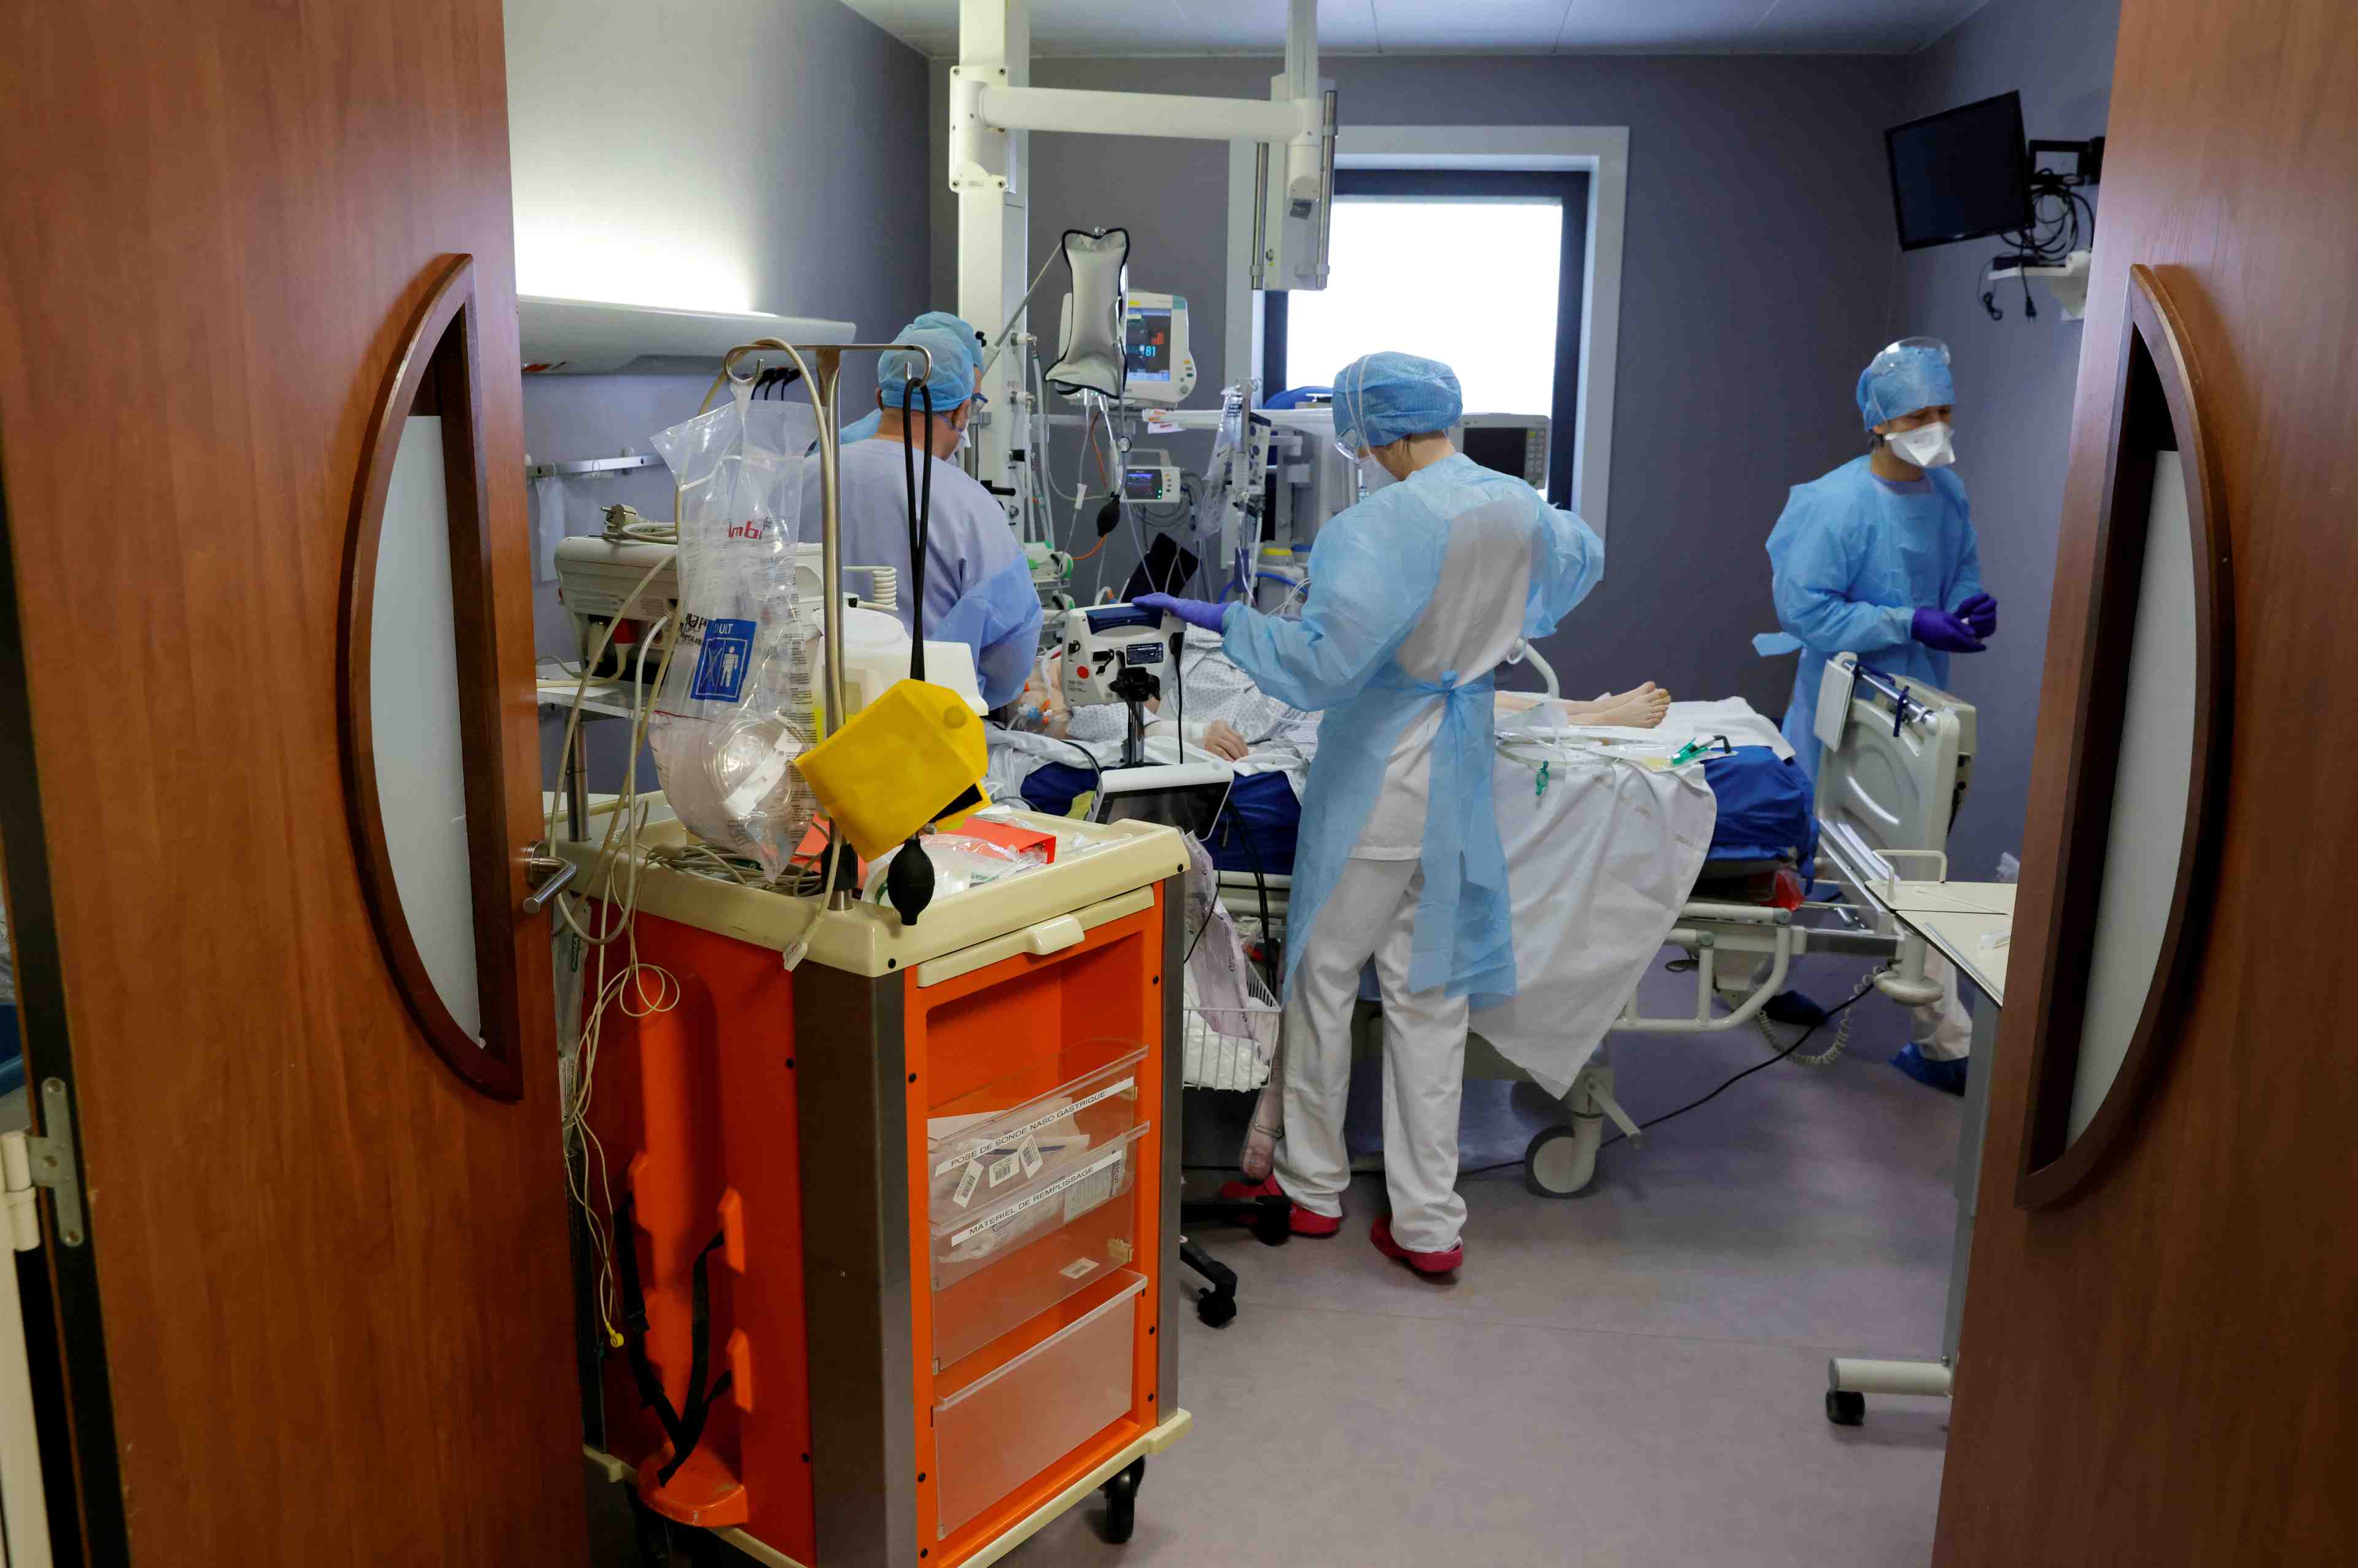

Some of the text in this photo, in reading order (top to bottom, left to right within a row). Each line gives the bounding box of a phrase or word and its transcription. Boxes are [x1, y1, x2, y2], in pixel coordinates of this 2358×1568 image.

[951, 1150, 978, 1166] POSE
[979, 1143, 993, 1154] DE
[995, 1128, 1027, 1147] SONDE
[1029, 1115, 1055, 1130] NASO
[1056, 1090, 1106, 1118] GASTRIQUE
[970, 1208, 1016, 1235] MATERIEL
[1018, 1198, 1032, 1209] DE
[1033, 1167, 1094, 1203] REMPLISSAGE
